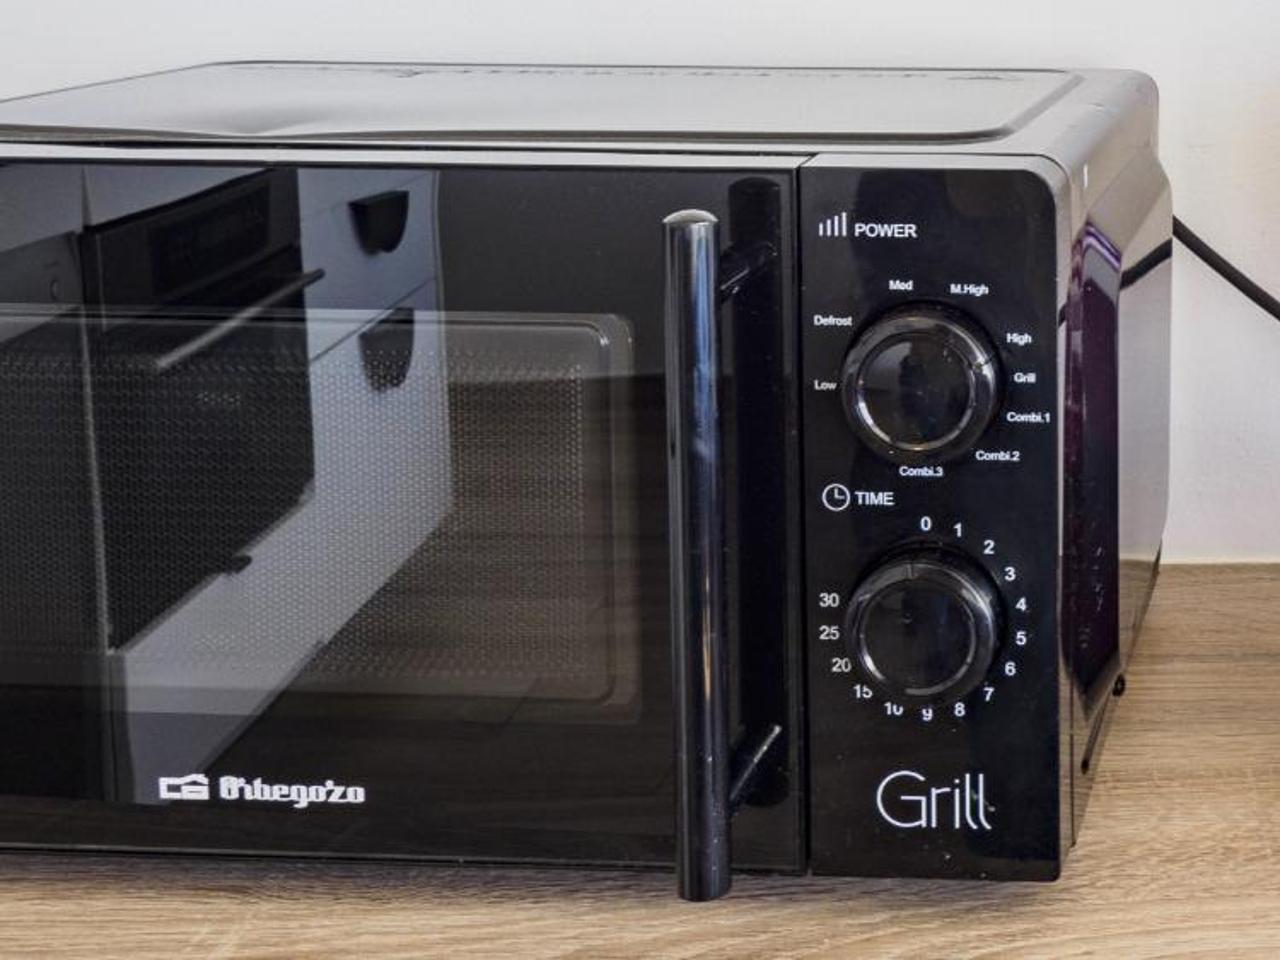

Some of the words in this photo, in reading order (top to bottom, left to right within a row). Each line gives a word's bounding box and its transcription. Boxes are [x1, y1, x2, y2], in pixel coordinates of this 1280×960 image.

[854, 223, 918, 238] POWER
[889, 280, 913, 291] Med
[950, 283, 989, 296] M.High
[813, 314, 853, 326] Defrost
[1006, 332, 1032, 345] High
[814, 379, 837, 390] Low
[1013, 372, 1037, 384] Grill
[1006, 411, 1051, 423] Combi.1
[975, 450, 1020, 461] Combi.2
[899, 465, 944, 477] Combi.3
[854, 491, 895, 506] TIME
[920, 517, 932, 531] 0
[953, 523, 963, 537] 1
[983, 540, 996, 555] 2
[1004, 566, 1017, 581] 3
[818, 592, 840, 608] 30
[1015, 597, 1028, 612] 4
[818, 625, 841, 641] 25
[1015, 631, 1027, 646] 5
[831, 657, 852, 673] 20
[1004, 661, 1017, 677] 6
[854, 685, 873, 700] 15
[983, 688, 995, 701] 7
[954, 702, 966, 718] 8
[875, 769, 994, 831] Grill
